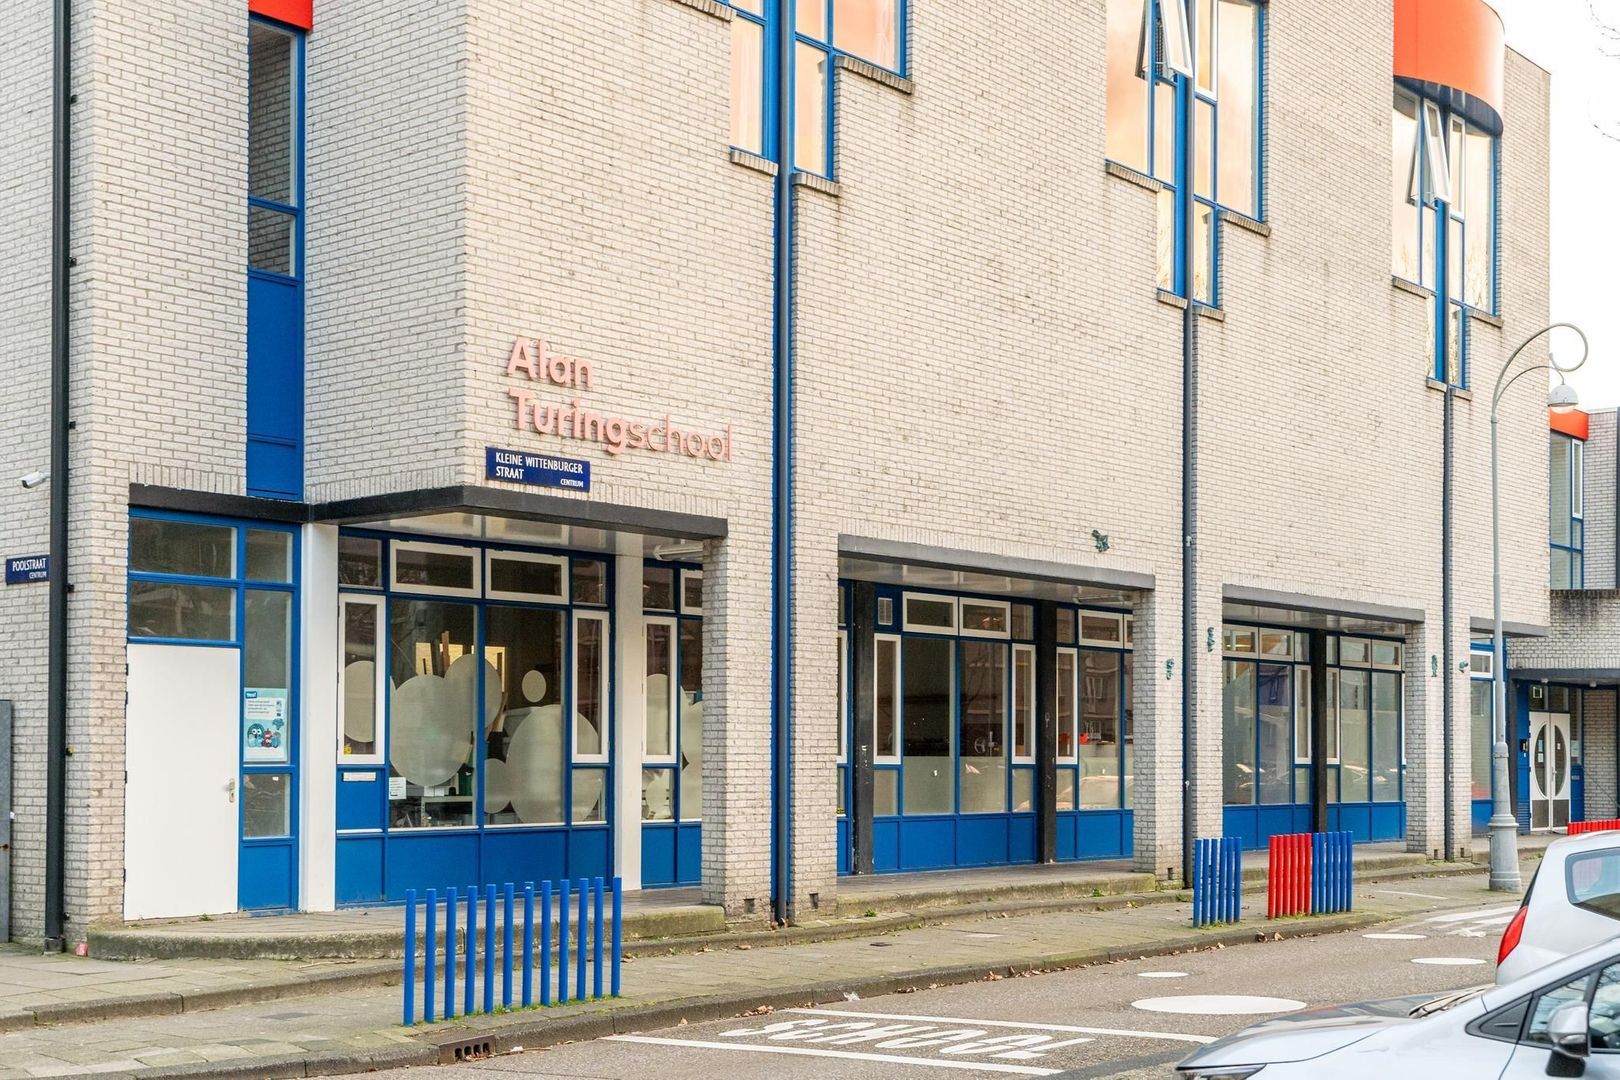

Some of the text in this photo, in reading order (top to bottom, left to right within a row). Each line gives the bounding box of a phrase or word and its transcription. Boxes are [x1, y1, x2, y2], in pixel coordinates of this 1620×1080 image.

[507, 336, 593, 389] Alan
[508, 388, 733, 462] Turingschool
[495, 452, 583, 474] KLEINE WITTENBURGER
[495, 466, 524, 480] STRAAT
[560, 478, 584, 488] CENTRUM
[12, 558, 46, 571] POOLSTRAAT
[718, 1019, 1096, 1060] SCHOOL
